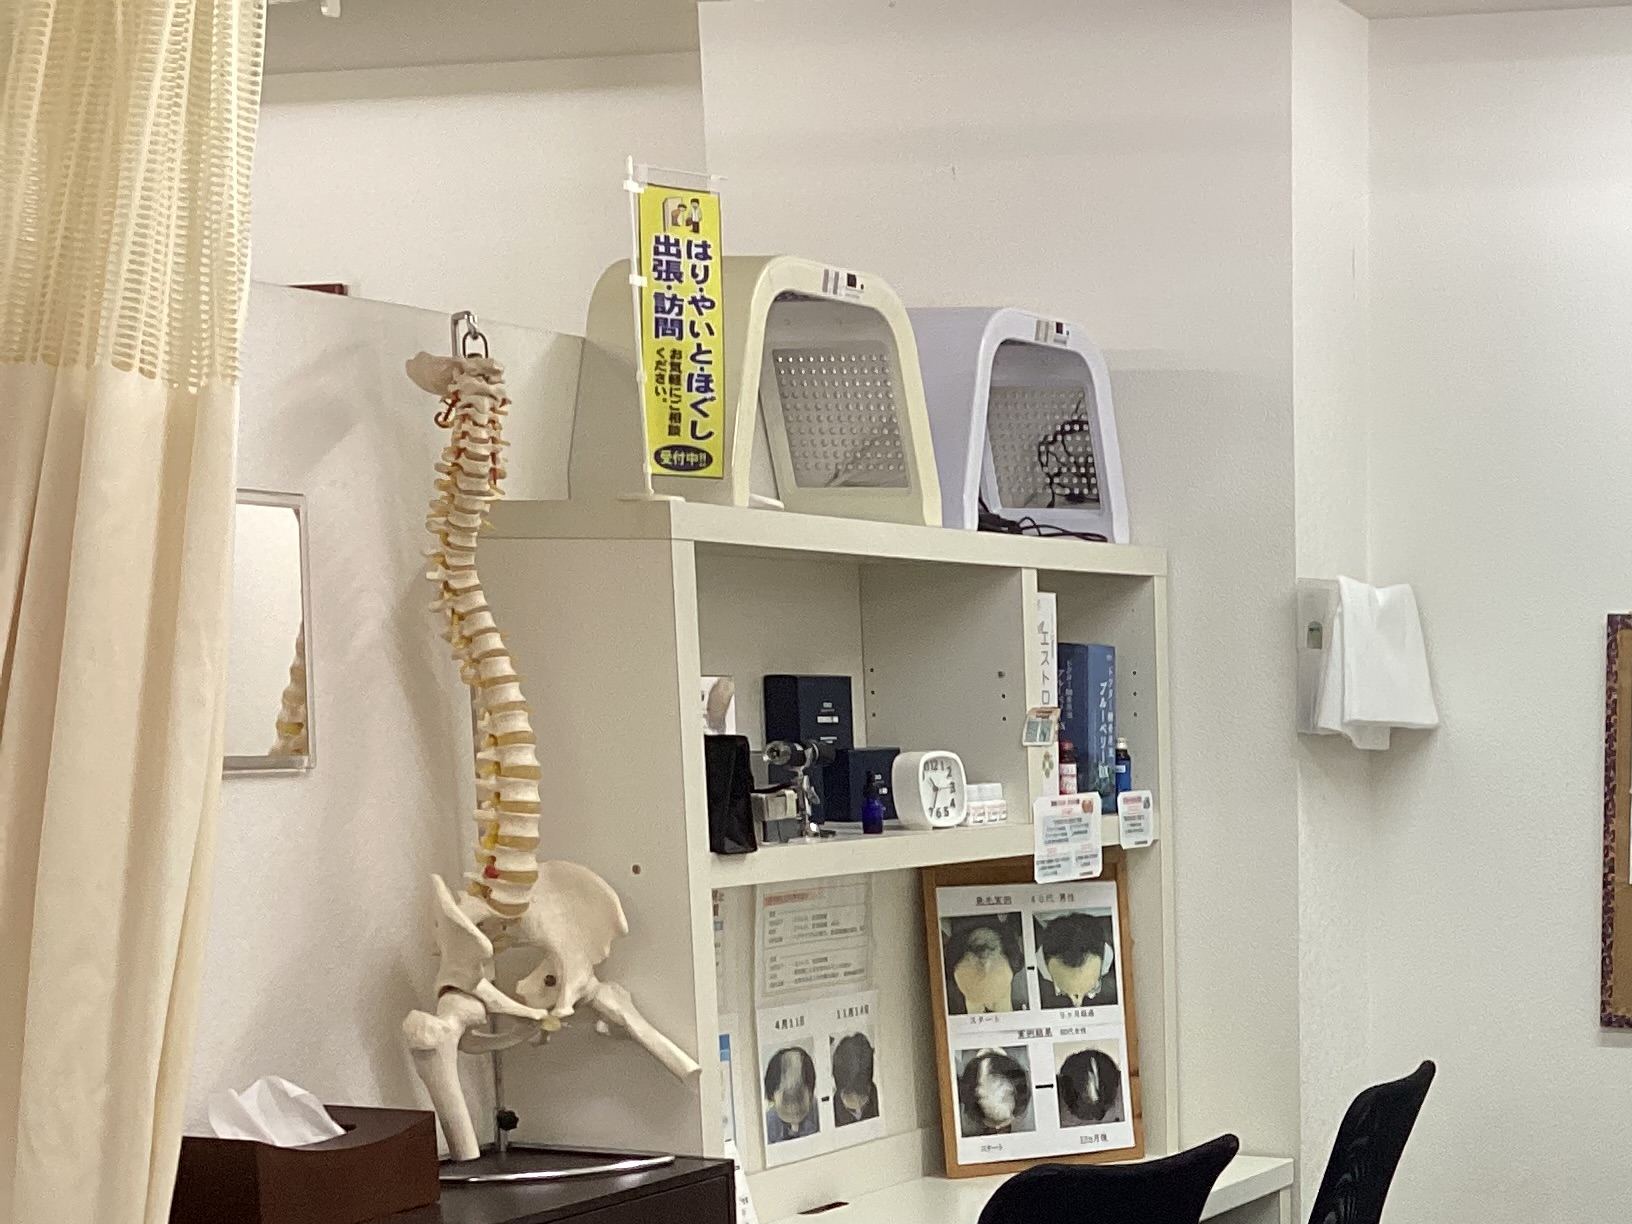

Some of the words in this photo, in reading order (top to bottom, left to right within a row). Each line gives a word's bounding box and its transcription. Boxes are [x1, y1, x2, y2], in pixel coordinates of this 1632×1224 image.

[652, 234, 685, 341] 出張・訪問
